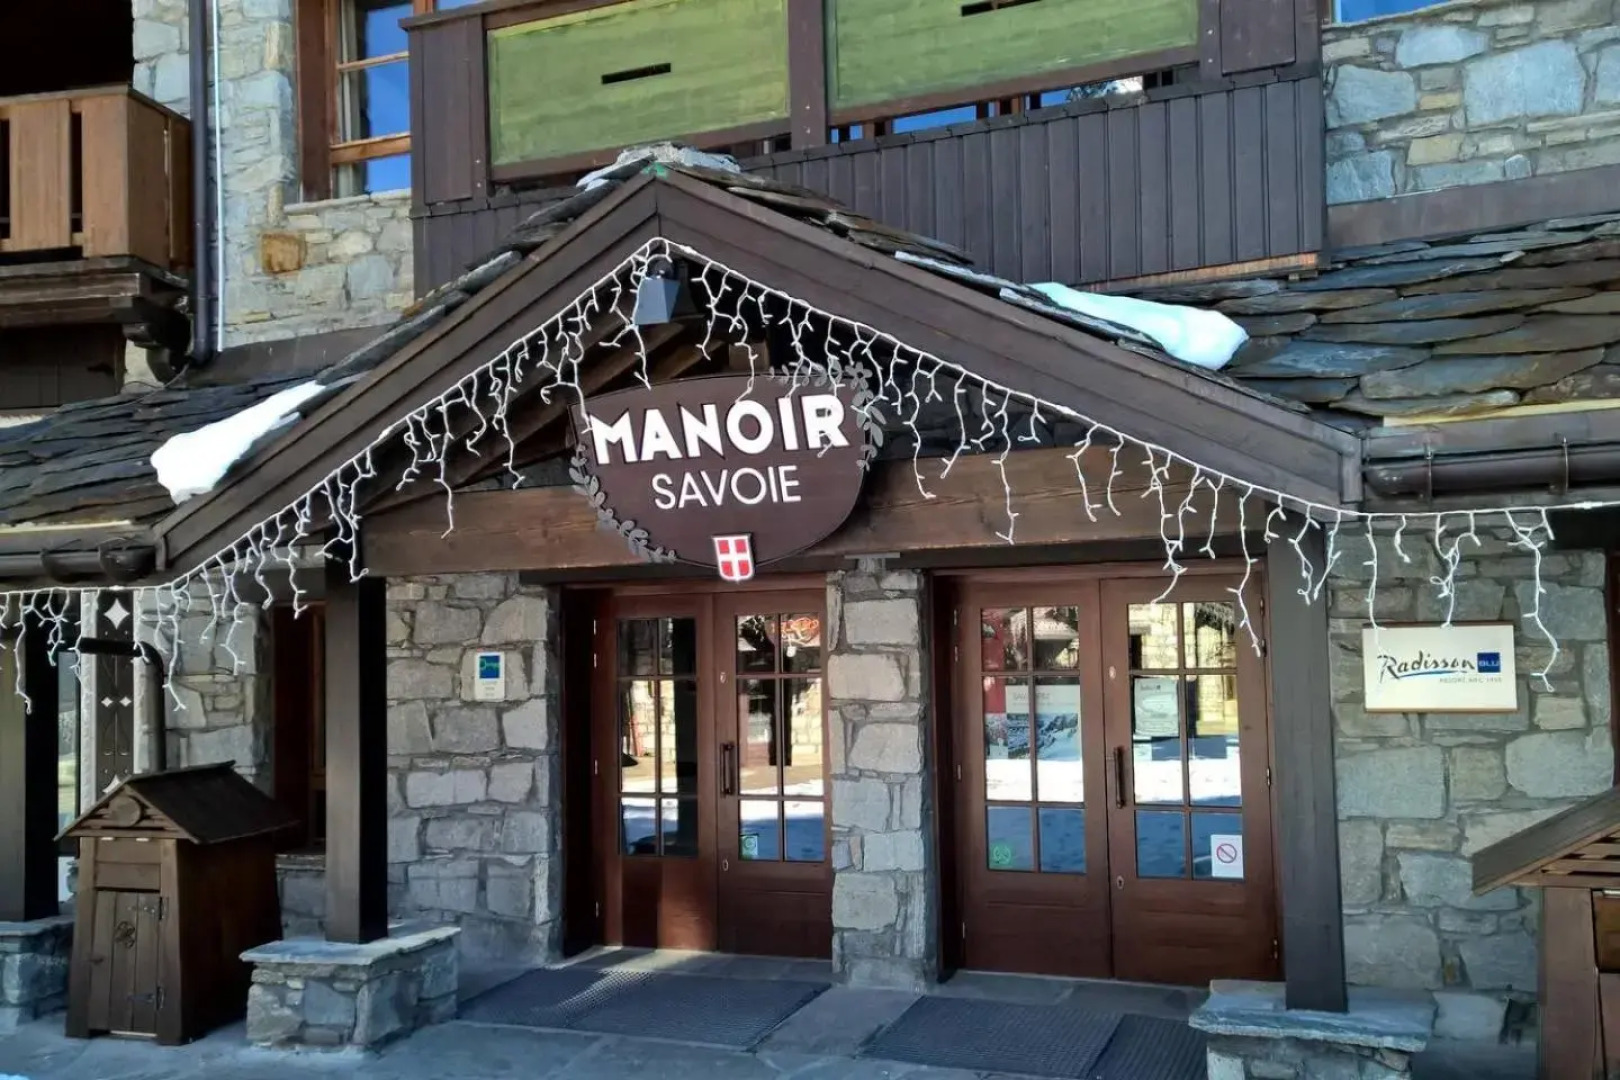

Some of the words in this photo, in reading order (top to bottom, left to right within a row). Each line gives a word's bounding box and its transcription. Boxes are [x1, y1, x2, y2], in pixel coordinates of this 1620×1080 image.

[589, 394, 850, 466] MANOIR
[651, 465, 802, 510] SAVOIE
[1377, 650, 1475, 684] Radisson
